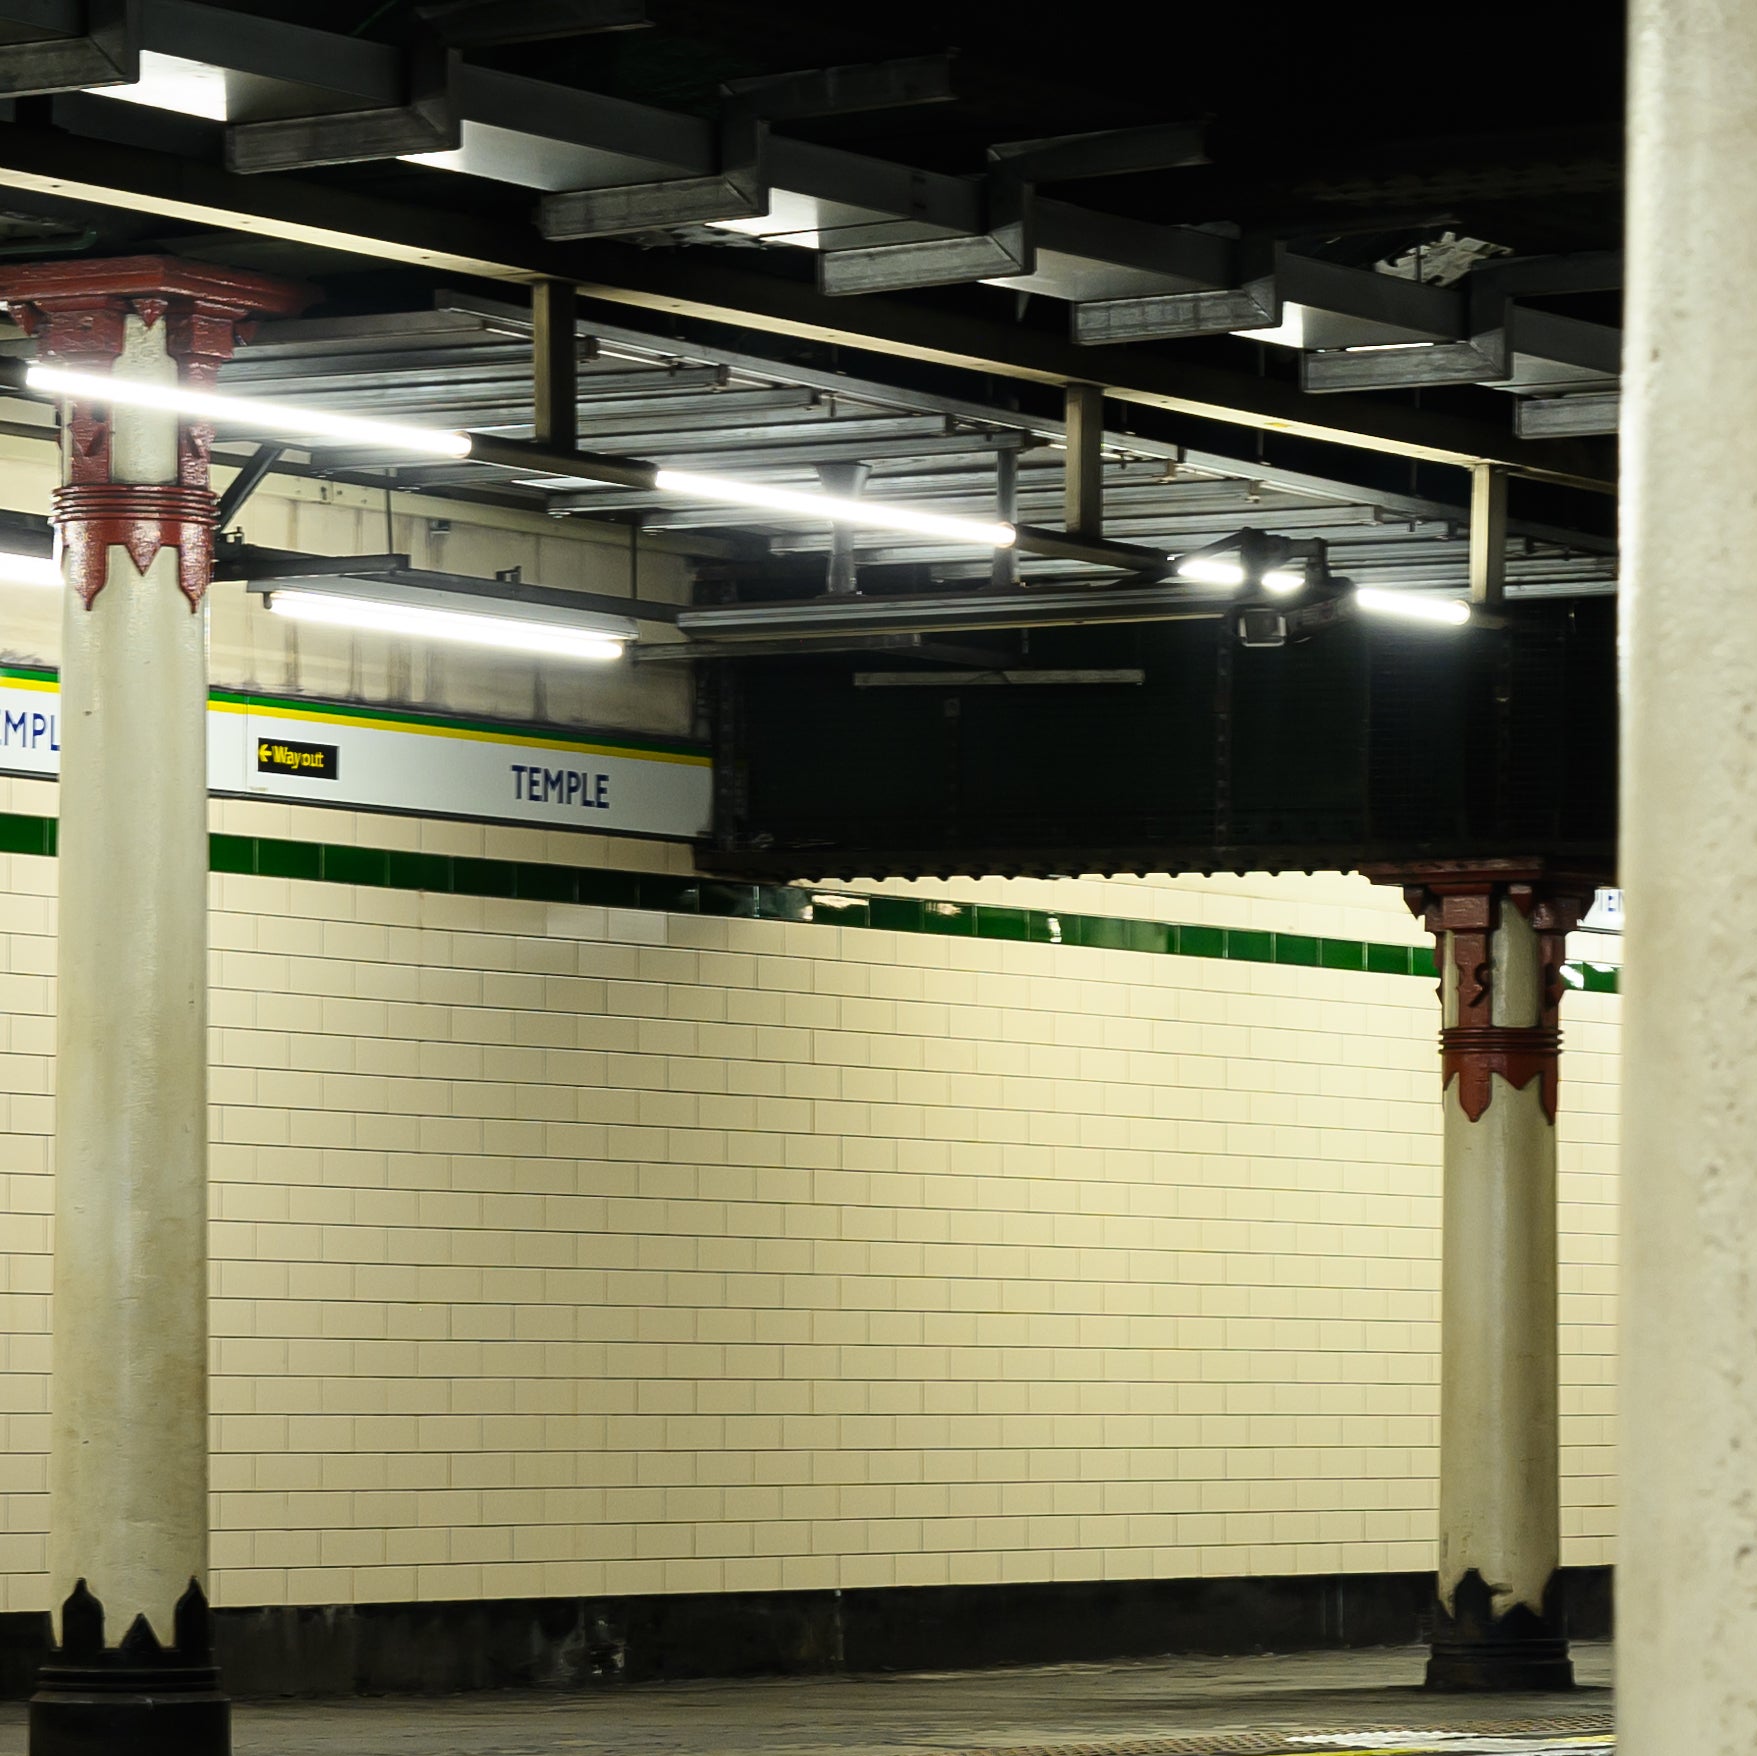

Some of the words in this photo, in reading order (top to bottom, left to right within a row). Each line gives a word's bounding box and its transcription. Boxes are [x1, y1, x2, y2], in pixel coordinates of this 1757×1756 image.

[0, 709, 60, 751] MPL
[271, 745, 301, 769] Way
[301, 752, 324, 768] out
[510, 764, 610, 809] TEMPLE
